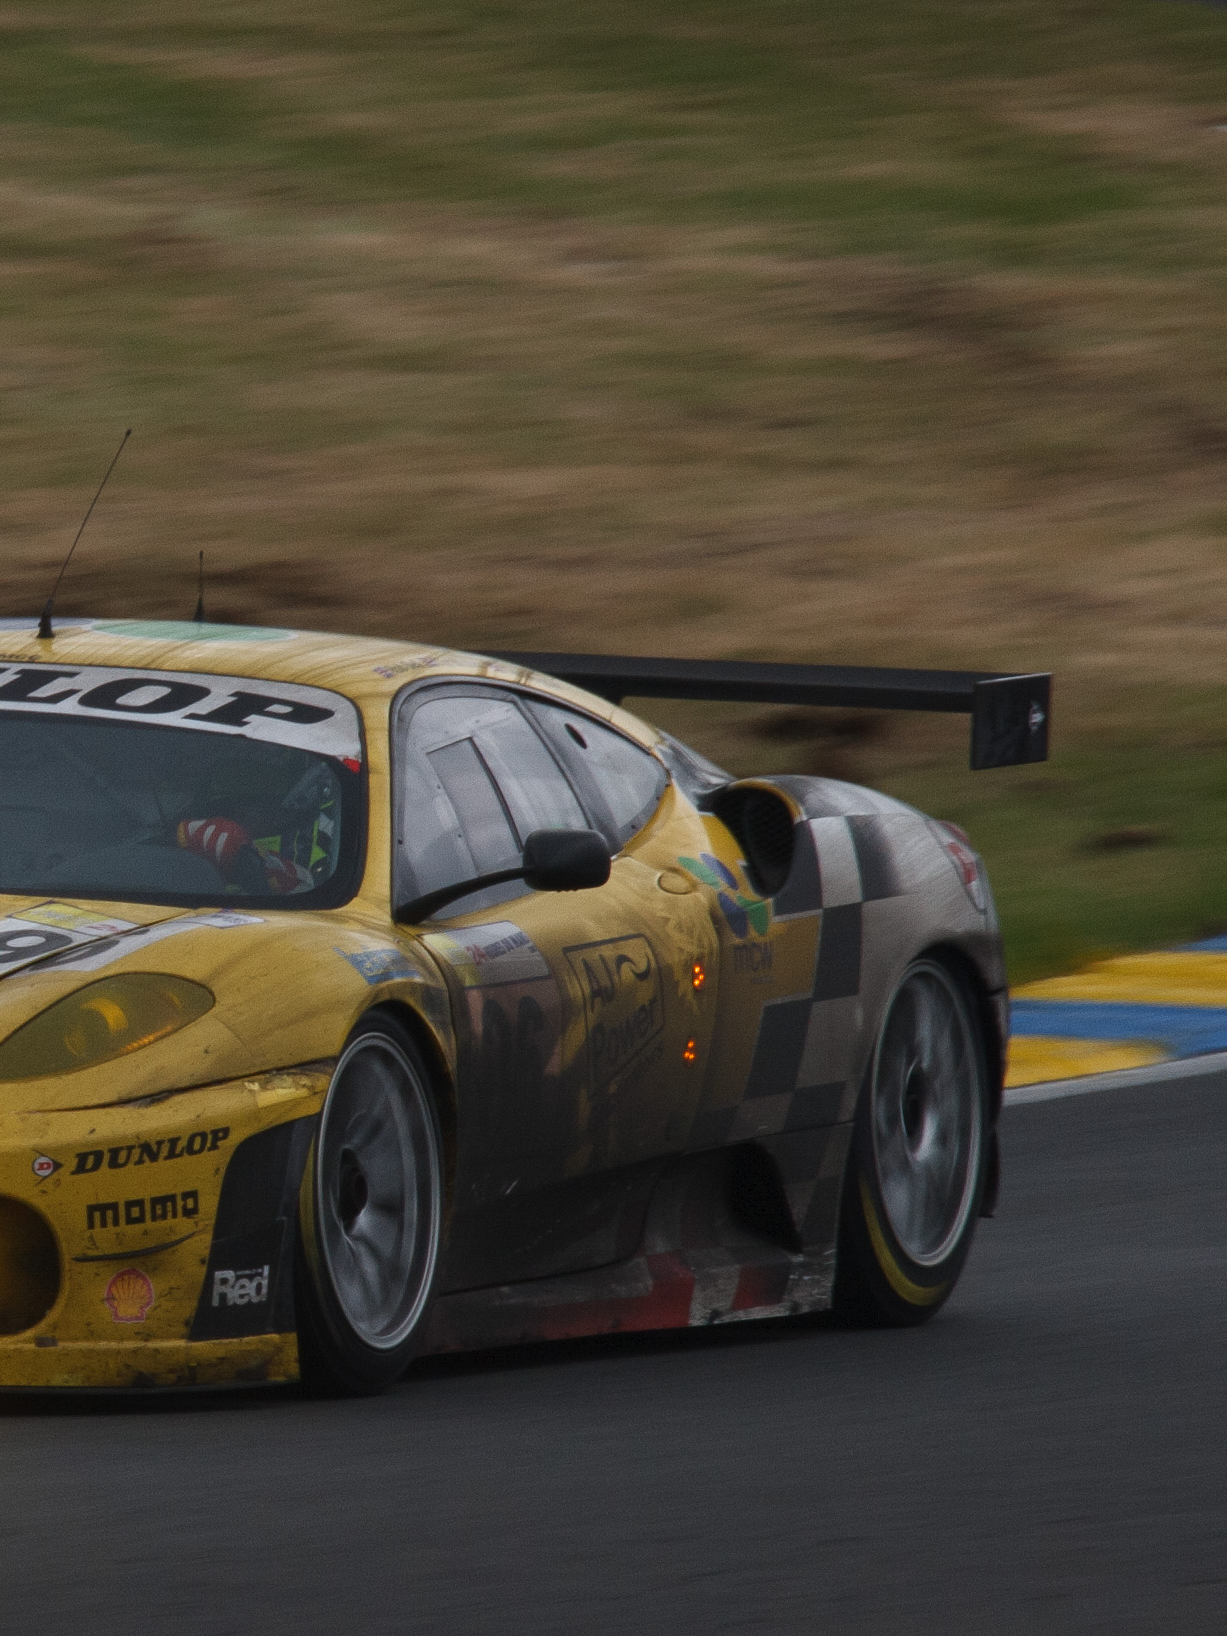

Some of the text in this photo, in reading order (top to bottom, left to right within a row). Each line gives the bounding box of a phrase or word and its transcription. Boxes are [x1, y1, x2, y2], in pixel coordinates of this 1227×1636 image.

[71, 1127, 230, 1175] DUNLOP
[86, 1189, 200, 1230] momo
[211, 1265, 269, 1307] Red
